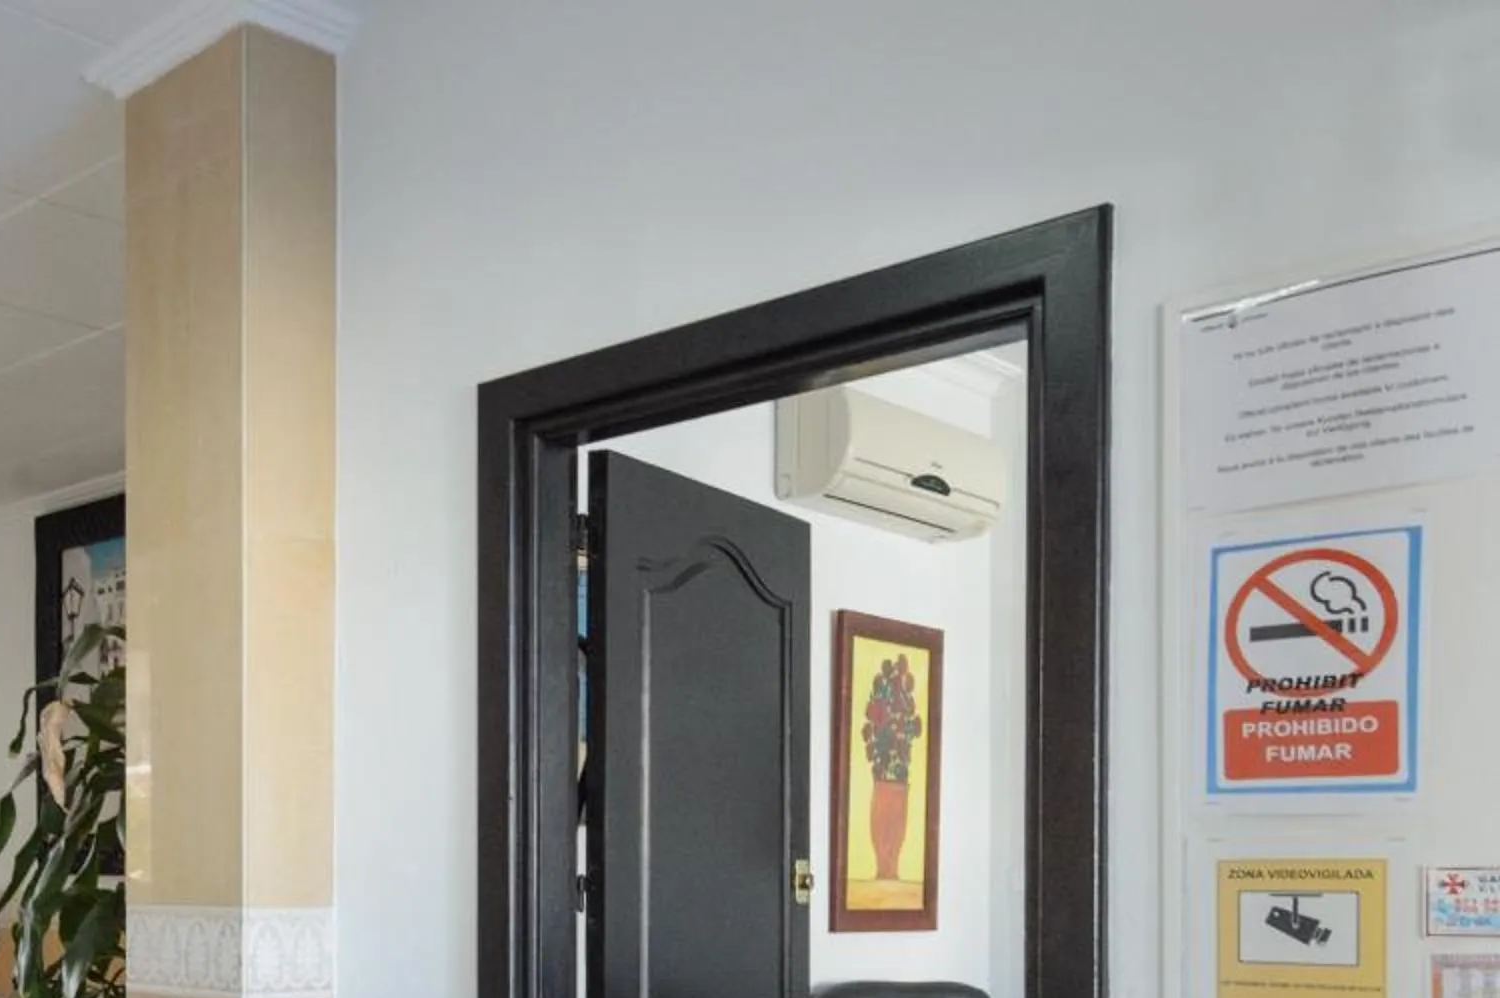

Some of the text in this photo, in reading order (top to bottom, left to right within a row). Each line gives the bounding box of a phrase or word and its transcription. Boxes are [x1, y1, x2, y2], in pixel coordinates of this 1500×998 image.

[1246, 671, 1365, 693] PROHIBIT
[1260, 697, 1347, 716] FUMAR
[1241, 715, 1379, 738] PROHIBIDO
[1265, 743, 1353, 762] FUMAR
[1228, 867, 1375, 880] ZONA VIDEOVIGILADA
